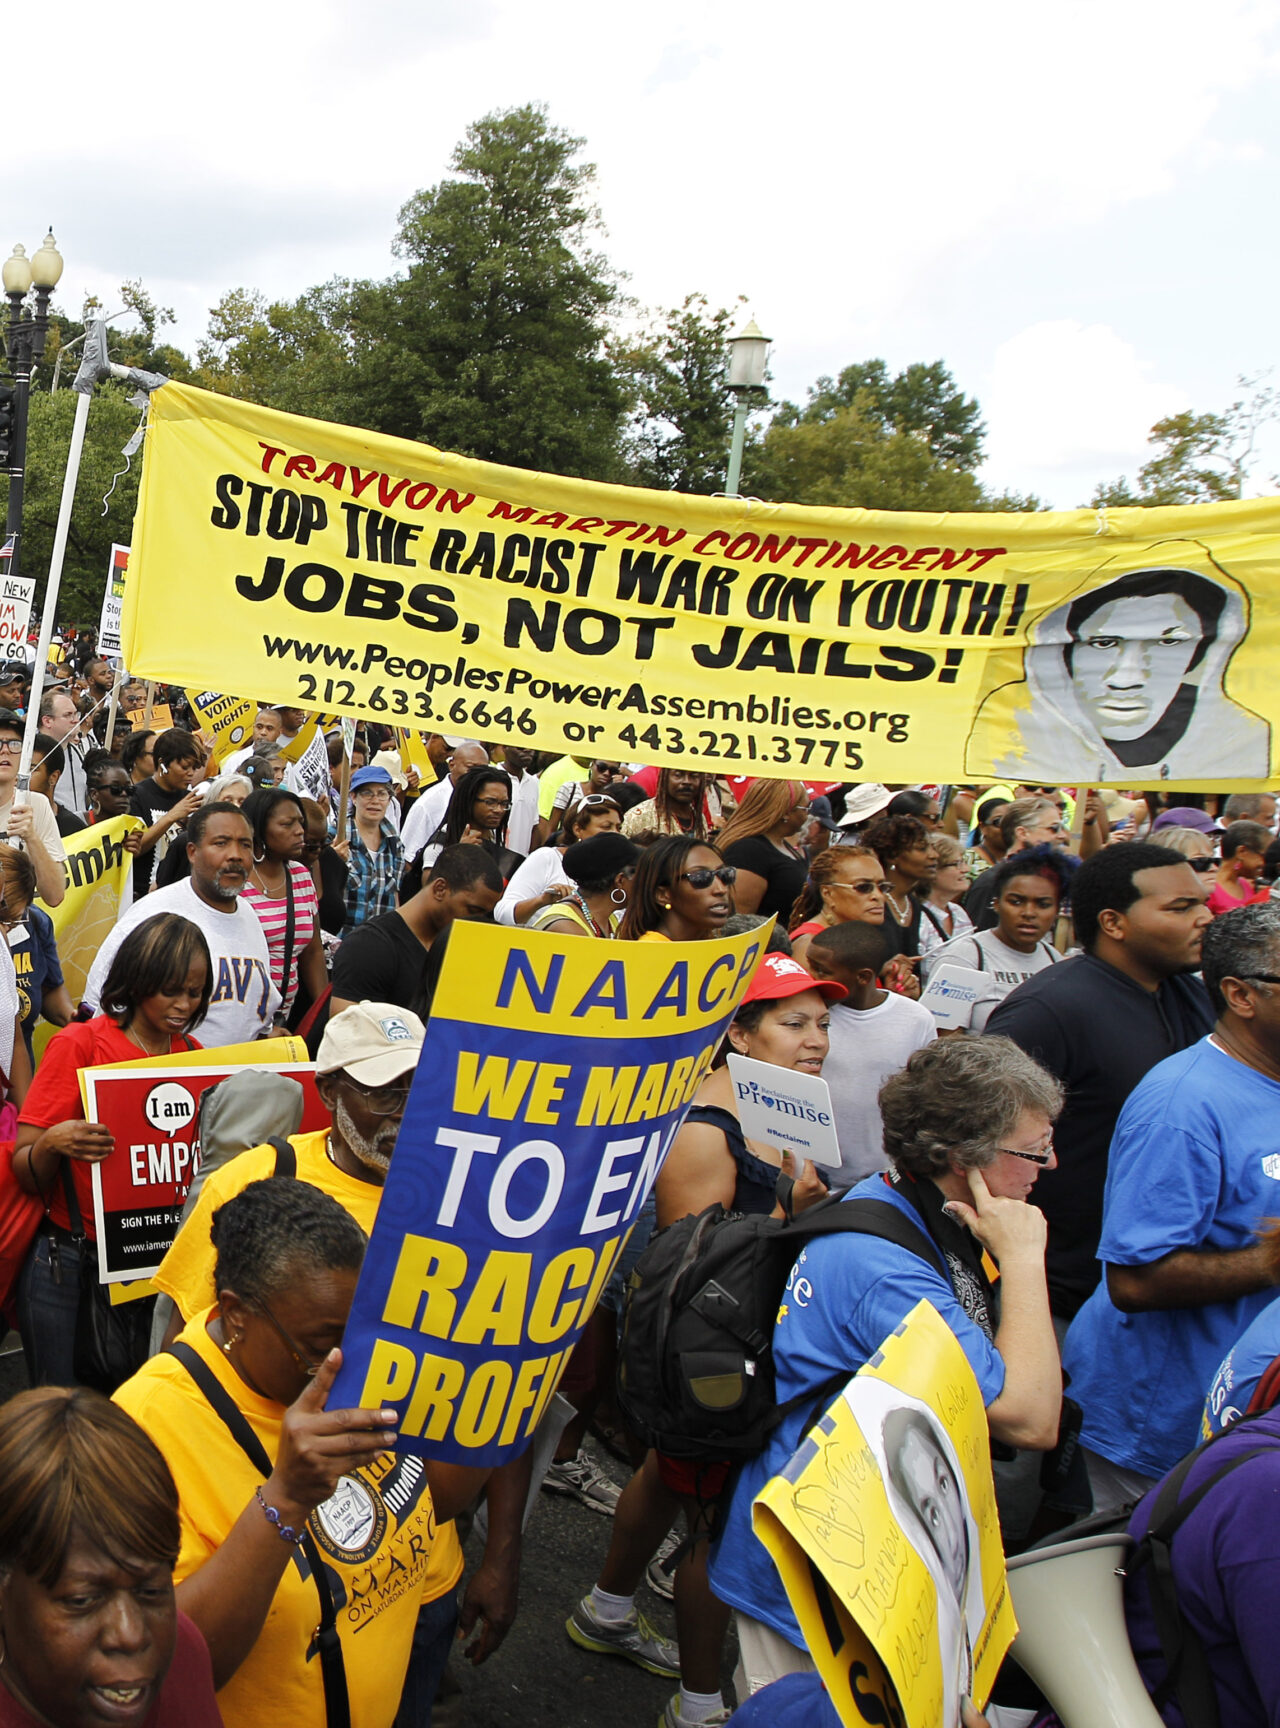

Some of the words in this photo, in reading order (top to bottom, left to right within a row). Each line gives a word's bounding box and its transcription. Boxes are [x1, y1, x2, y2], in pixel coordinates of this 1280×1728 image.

[258, 441, 476, 513] TRAYVON
[488, 500, 687, 547] MARTIN
[692, 530, 1008, 573] CONTINGENT
[211, 473, 328, 545] STOP
[340, 500, 423, 566] THE
[429, 527, 606, 597] RACIST
[617, 548, 738, 616] WAR
[747, 572, 826, 624] ON
[837, 577, 1030, 637] YOUTH!
[3, 580, 31, 598] NEW
[106, 619, 114, 629] is
[235, 556, 481, 645] JOBS,
[504, 597, 675, 661] NOT
[691, 625, 965, 684] JAILS!
[6, 642, 25, 659] GO
[263, 634, 910, 744] www.PeoplesPowerAssemblies.org
[212, 701, 251, 734] RIGHTS
[299, 673, 537, 736] 212.633.6646
[563, 721, 605, 743] or
[618, 722, 864, 770] 443.221.3775
[209, 957, 270, 1023] AVY
[495, 942, 760, 1021] NAACP
[452, 1051, 572, 1126] WE
[761, 1086, 801, 1106] Reclaiming
[802, 1099, 815, 1108] the
[151, 1098, 159, 1118] I
[163, 1100, 191, 1118] am
[434, 1127, 566, 1239] TO
[121, 1217, 143, 1229] SIGN
[144, 1214, 162, 1226] THE
[332, 1501, 352, 1522] NAACP
[367, 1486, 385, 1518] COLORED
[371, 1520, 385, 1548] PEOPLE
[348, 1597, 373, 1623] ON
[373, 1588, 407, 1618] SATURDAY,
